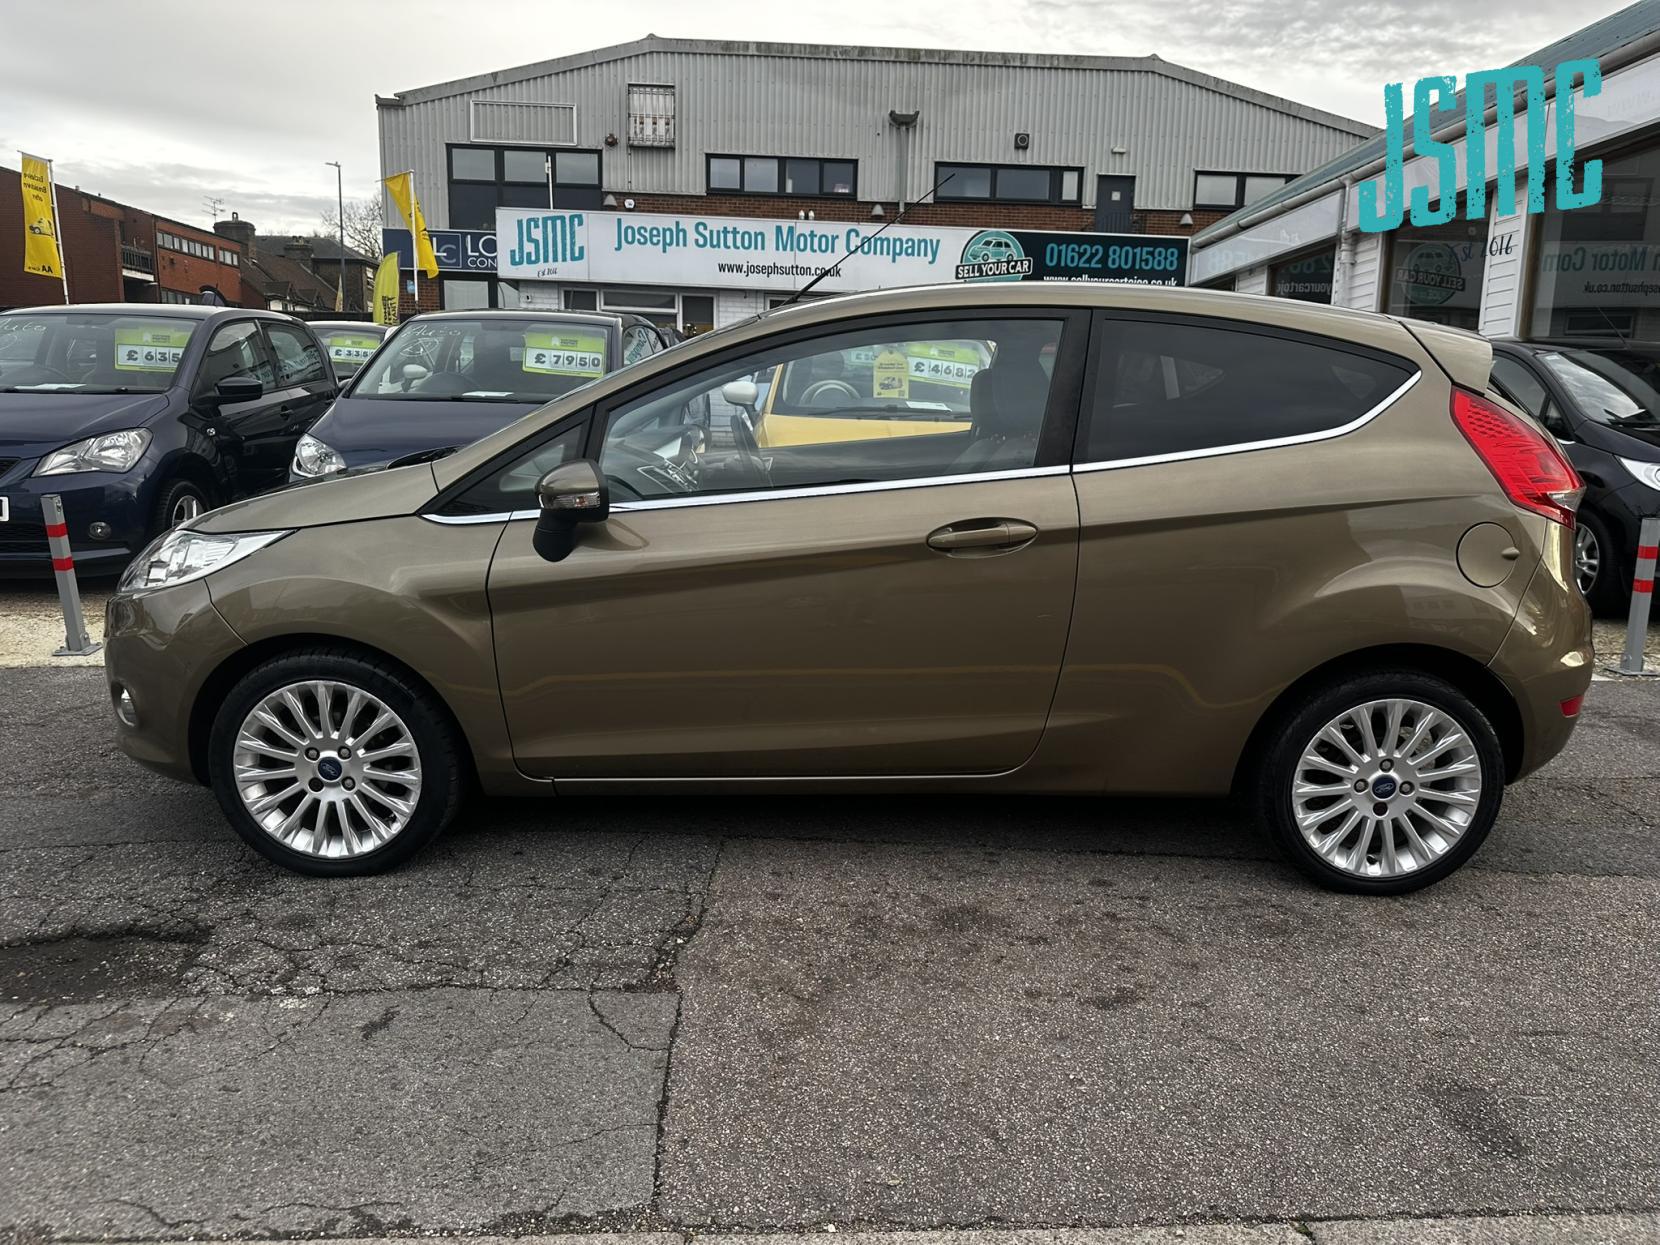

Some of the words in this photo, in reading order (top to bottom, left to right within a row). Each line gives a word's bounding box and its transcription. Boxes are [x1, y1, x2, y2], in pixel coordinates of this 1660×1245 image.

[510, 213, 585, 266] JSMC
[615, 217, 687, 253] Joseph
[694, 221, 765, 251] Sutton
[775, 225, 839, 254] Motor
[845, 228, 941, 265] Company
[958, 265, 980, 278] SELL
[981, 263, 1008, 275] YOUR
[1008, 260, 1029, 273] CAR
[1045, 243, 1103, 268] 01622
[1108, 245, 1178, 271] 801588
[534, 353, 601, 367] £7950
